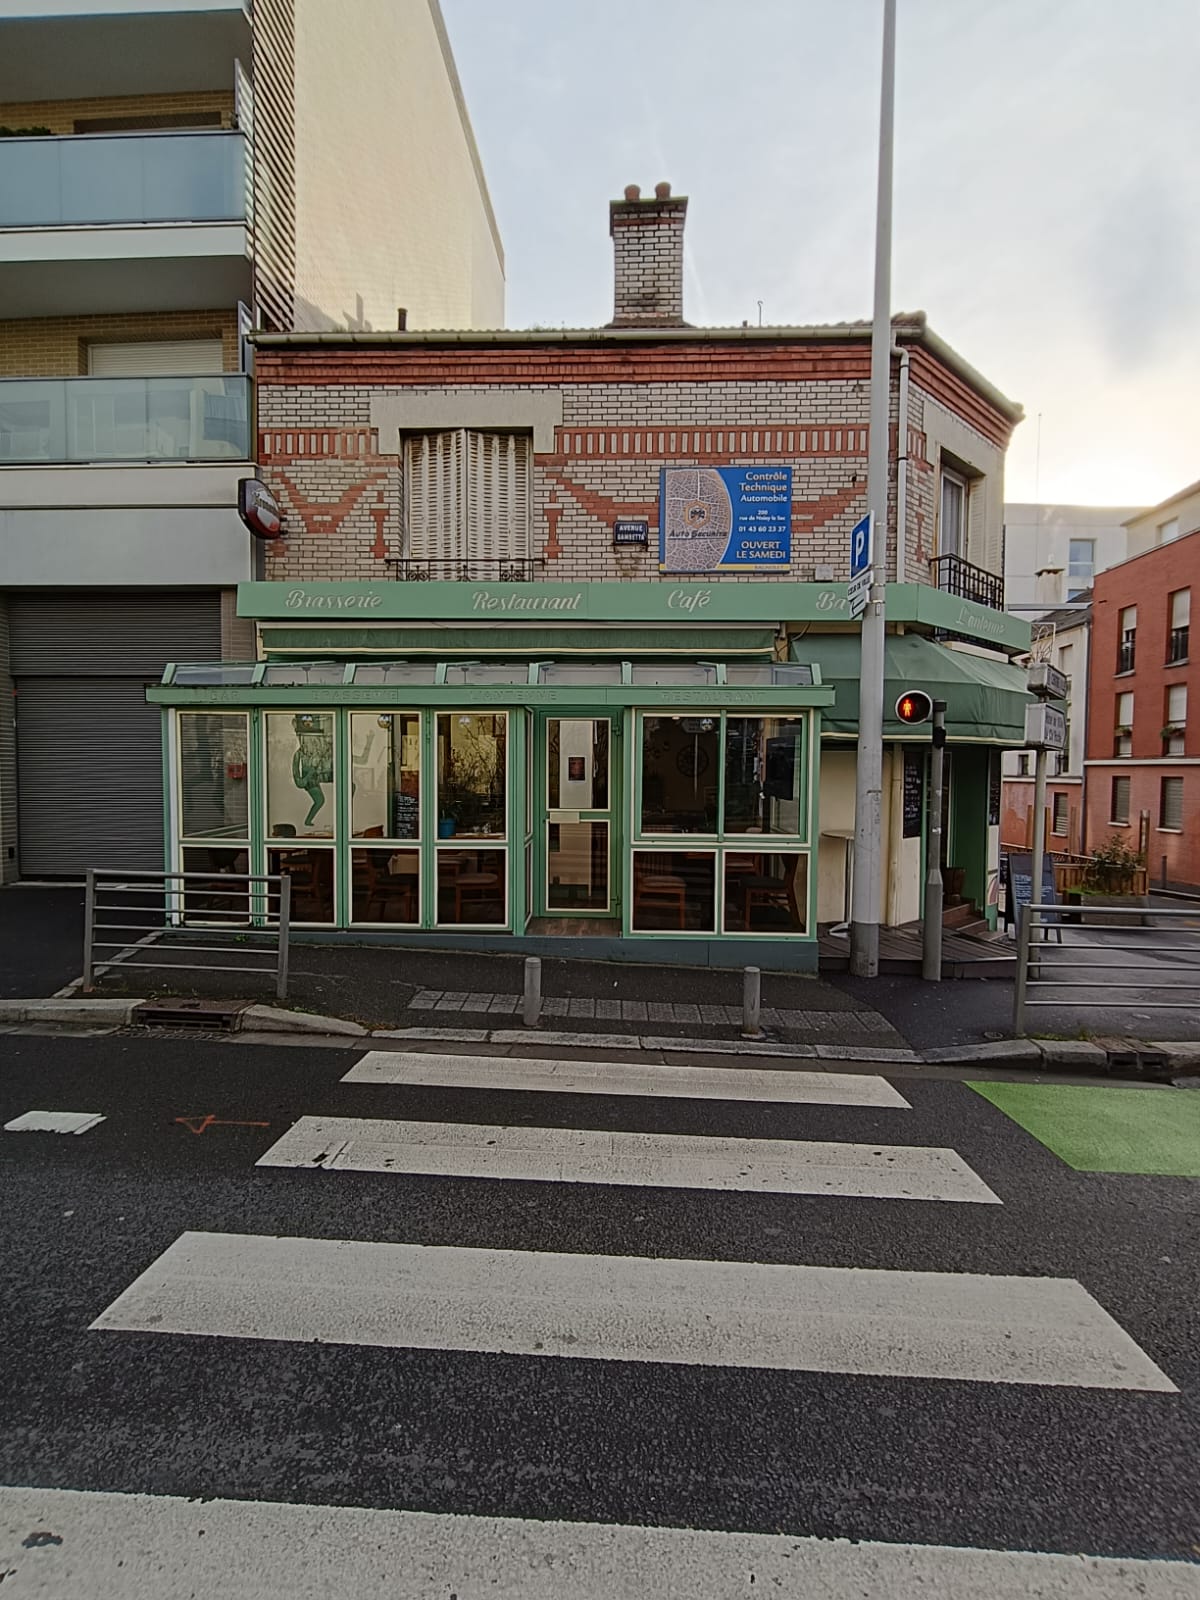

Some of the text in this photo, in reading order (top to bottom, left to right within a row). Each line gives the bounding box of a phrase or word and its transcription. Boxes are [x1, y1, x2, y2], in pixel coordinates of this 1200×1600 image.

[745, 471, 788, 481] Contrôle
[739, 482, 788, 493] Technique
[740, 494, 788, 502] Automobile
[619, 524, 643, 532] AVENUE
[669, 530, 690, 538] Auto
[741, 541, 782, 549] OUVERT
[855, 530, 865, 567] P
[736, 550, 786, 559] LE SAMEDI
[284, 589, 848, 614] Brasserie Restaurant Café Ba
